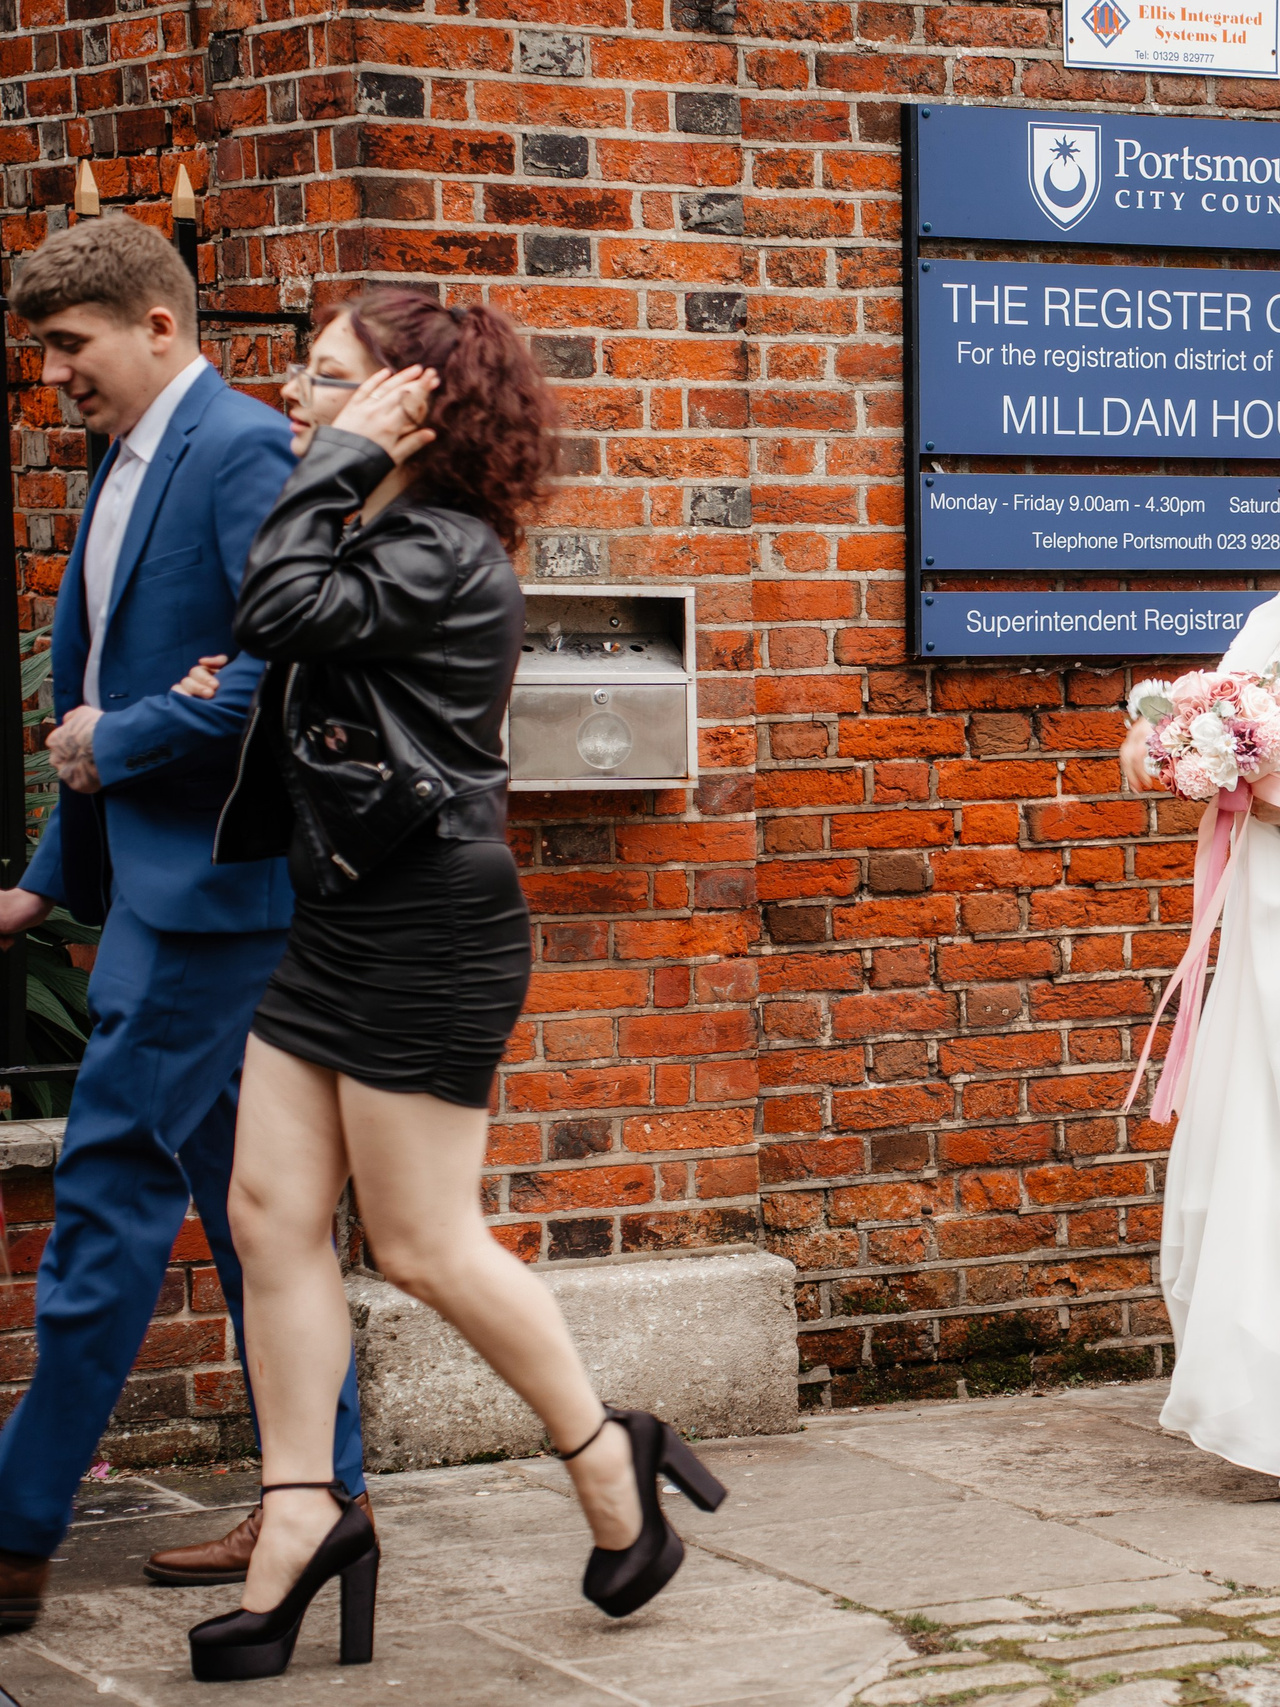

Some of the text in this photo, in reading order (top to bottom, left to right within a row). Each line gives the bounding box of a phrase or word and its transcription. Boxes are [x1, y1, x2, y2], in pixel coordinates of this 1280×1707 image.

[1140, 5, 1262, 26] Ellis Integrated
[1155, 24, 1246, 44] Systems Ltd
[1134, 49, 1214, 62] Tel: 01329 829777
[1115, 190, 1184, 210] CITY
[943, 284, 1028, 325] THE
[1045, 287, 1251, 331] REGISTER
[958, 342, 994, 364] For
[1001, 343, 1035, 365] the
[1045, 345, 1166, 372] registration
[1175, 348, 1246, 371] district
[1254, 350, 1273, 371] of
[1004, 395, 1195, 436] MILLDAM
[931, 493, 997, 514] Monday
[1014, 494, 1064, 515] Friday
[1070, 496, 1129, 511] 9.00am
[1145, 497, 1204, 516] 4.30pm
[1032, 532, 1117, 552] Telephone
[1124, 533, 1212, 549] Portsmouth
[1217, 534, 1246, 549] 023
[967, 609, 1243, 637] Superintendent Registrar
